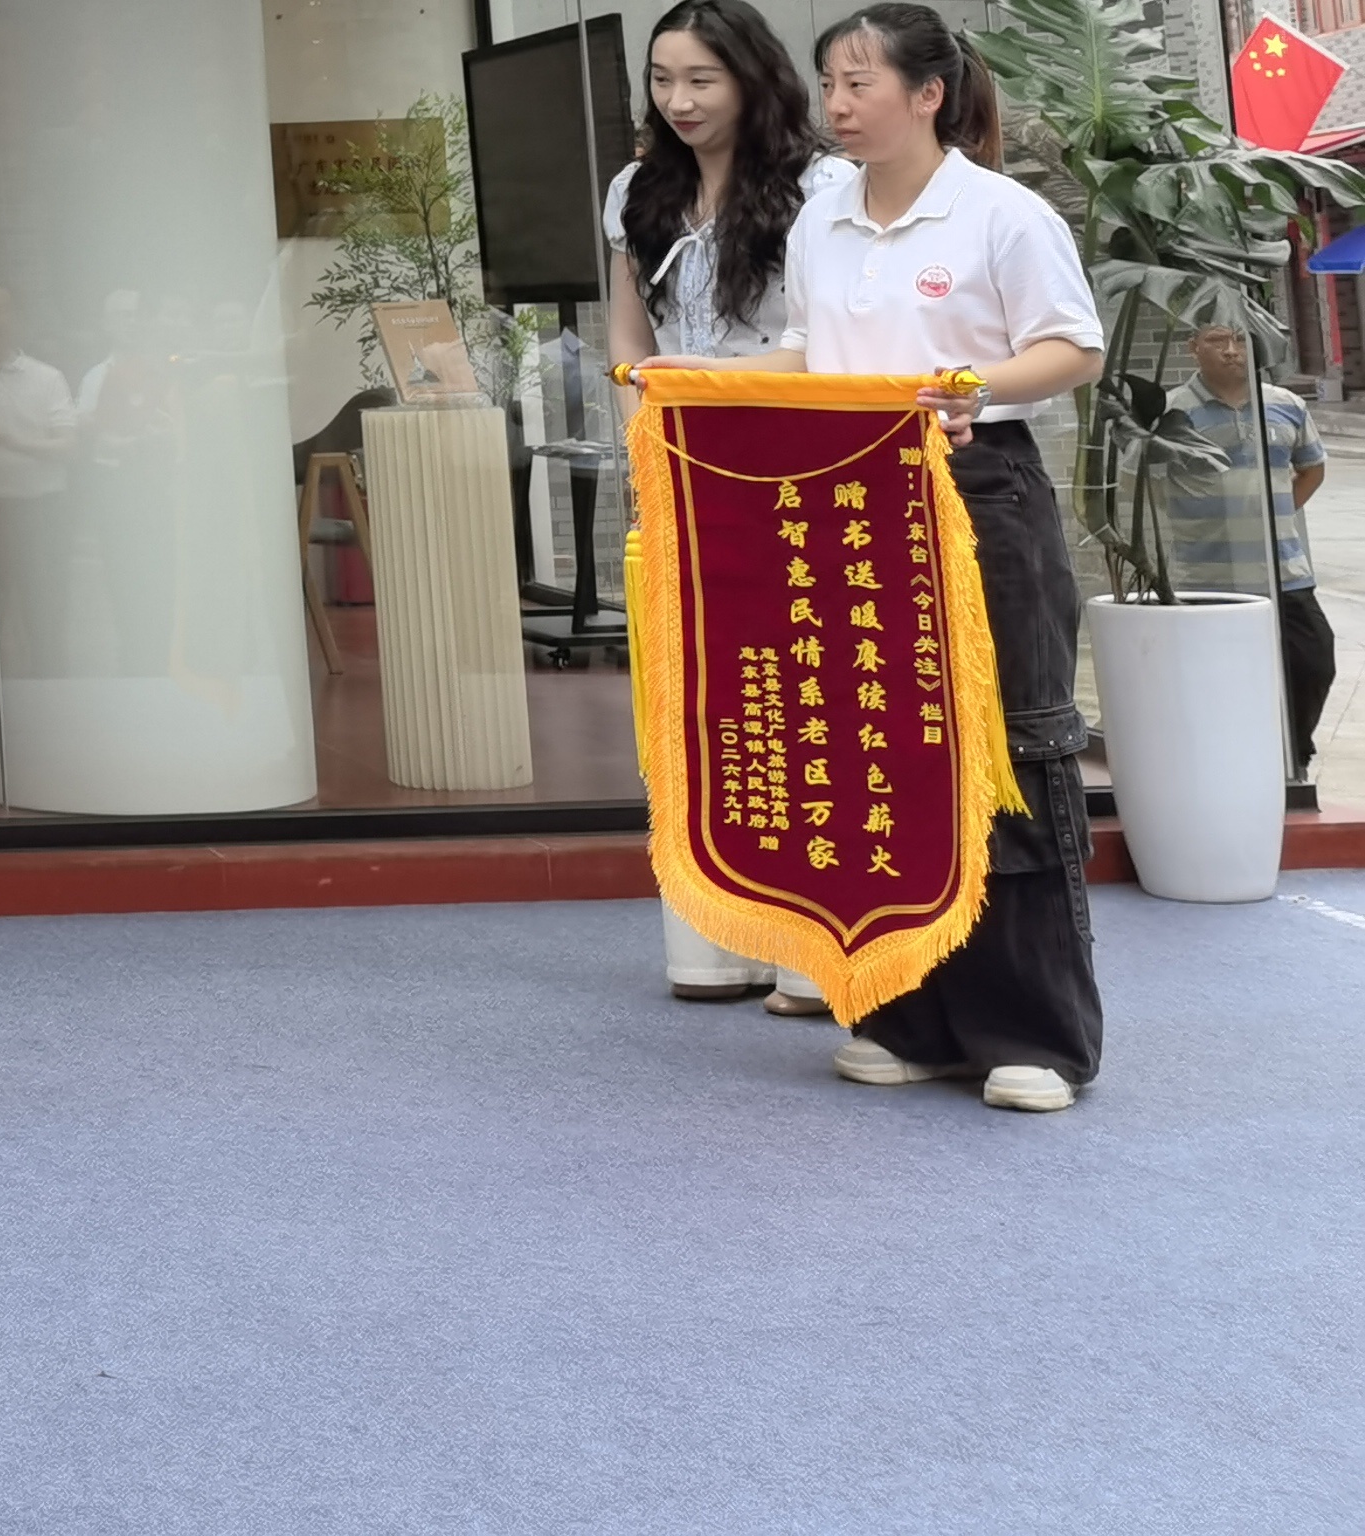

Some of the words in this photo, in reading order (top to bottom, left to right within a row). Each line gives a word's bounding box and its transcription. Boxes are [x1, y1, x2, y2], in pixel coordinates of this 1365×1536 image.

[738, 645, 770, 830] 惠东县高潭镇人民政府
[759, 646, 791, 831] 惠东县文化广电旅游体育局
[771, 479, 841, 871] 启智惠民情系老区万家
[833, 481, 901, 879] 赠书送暖赓续红色薪火
